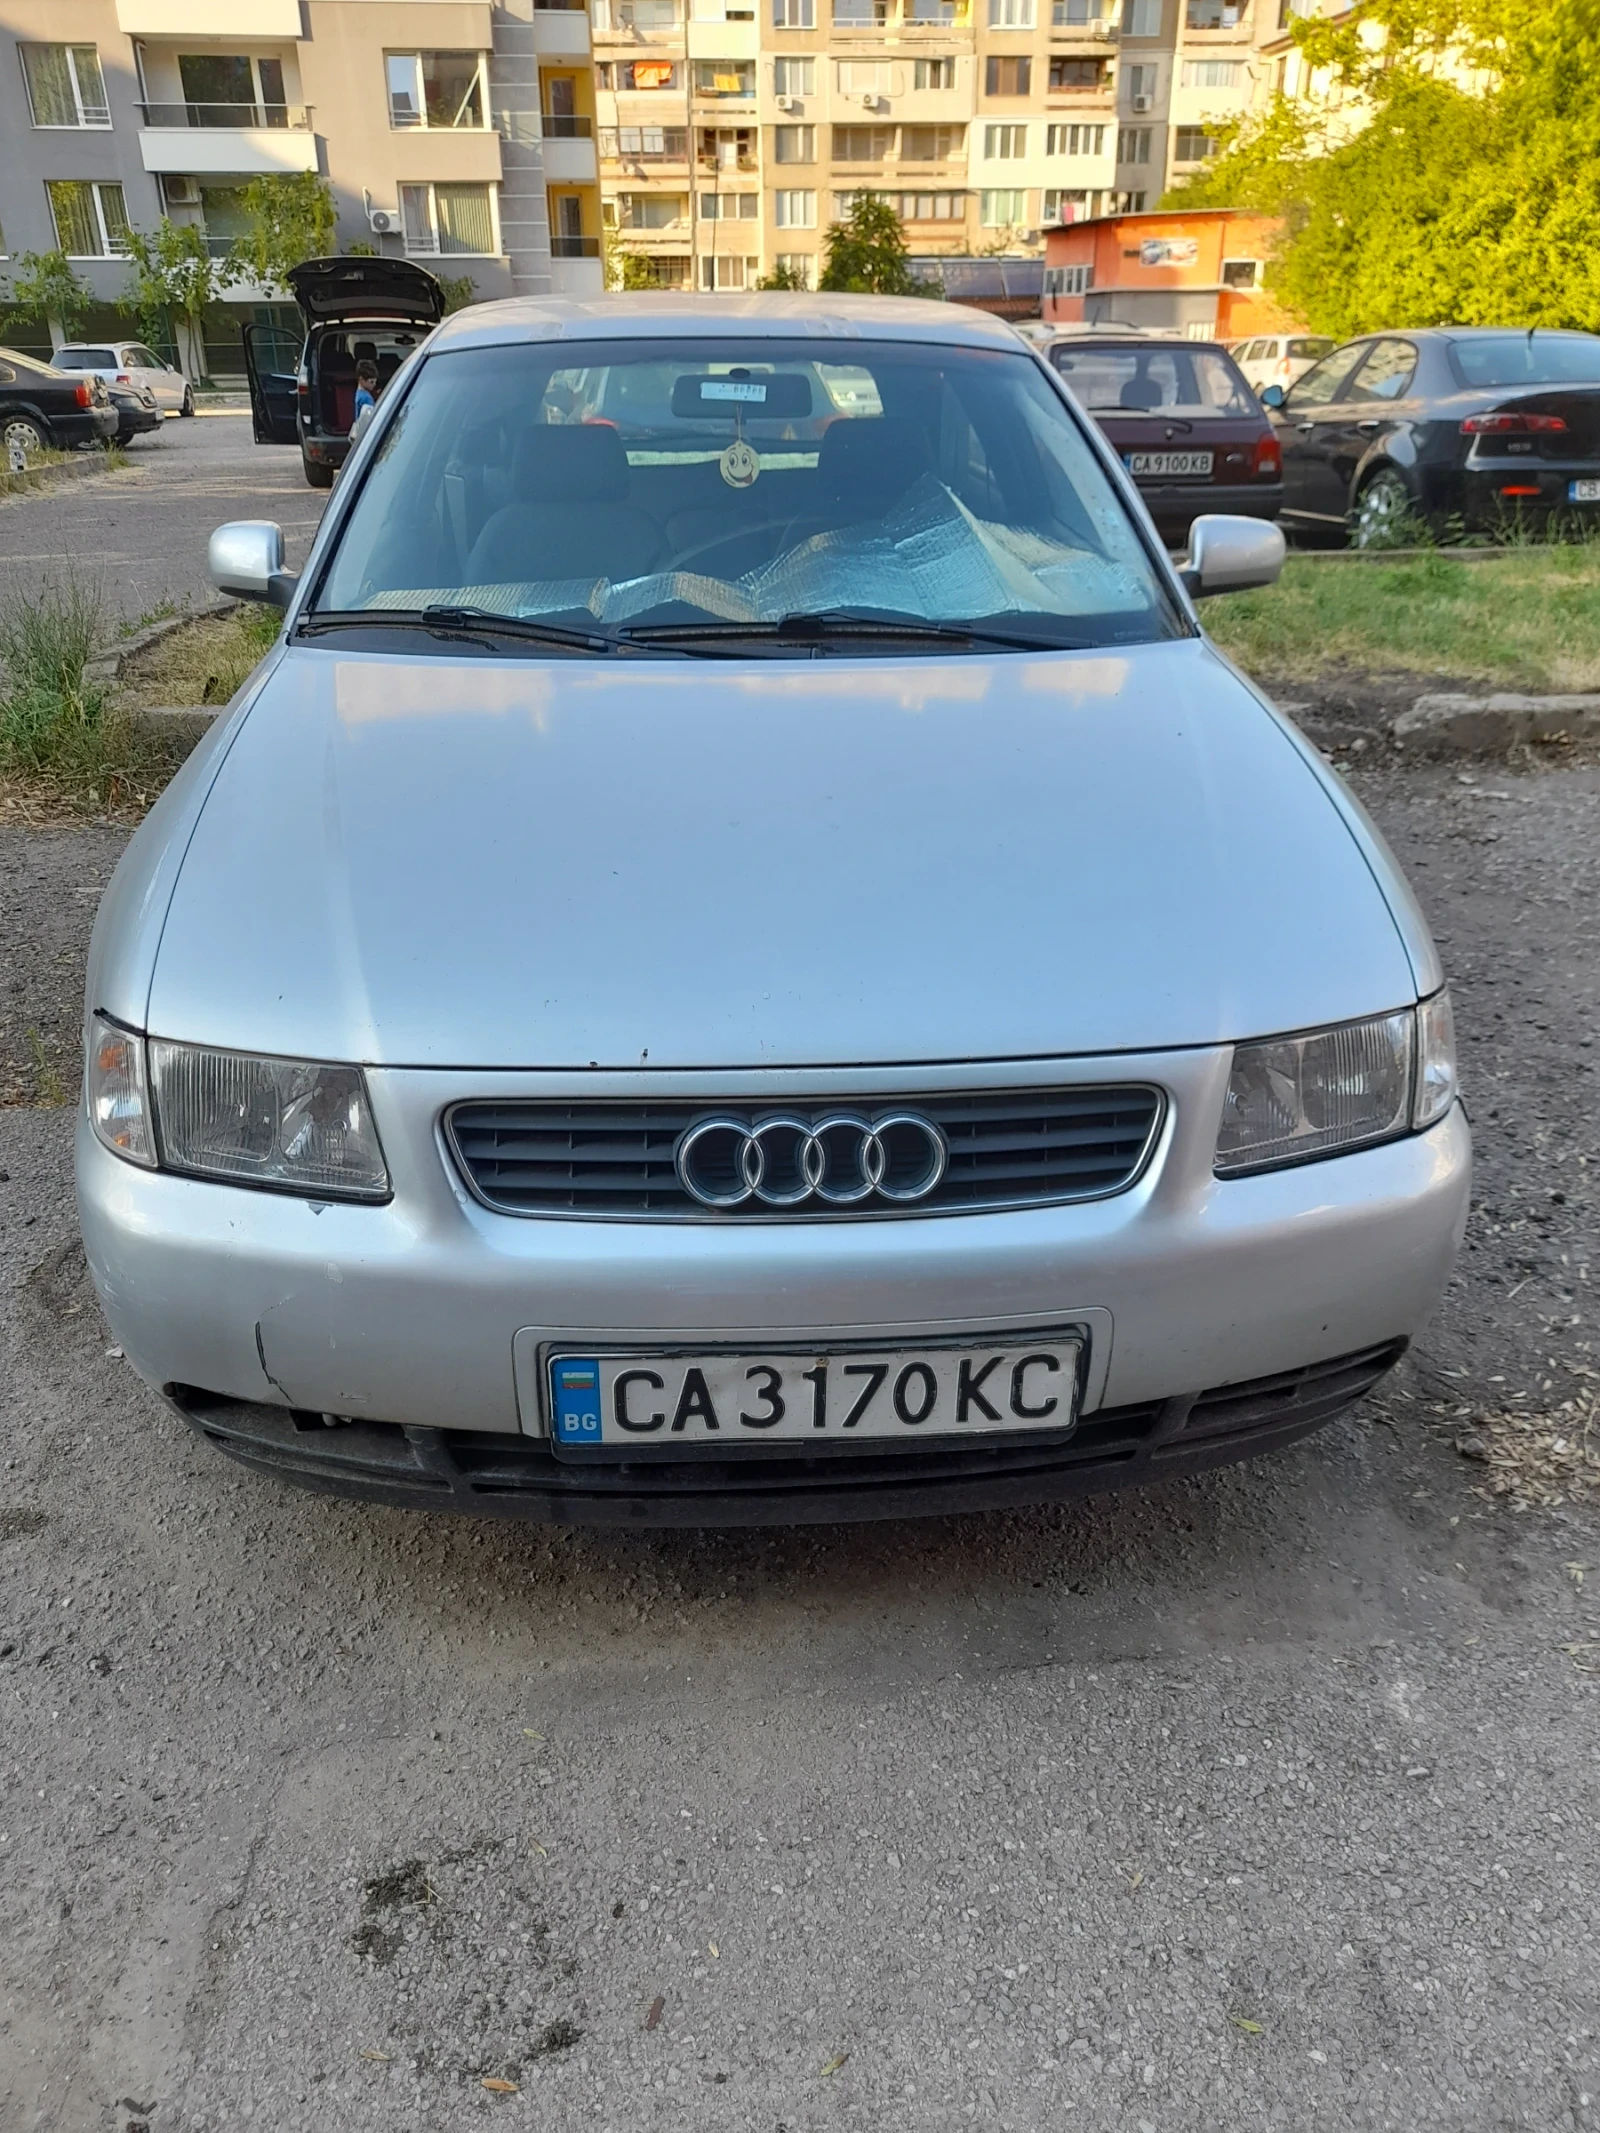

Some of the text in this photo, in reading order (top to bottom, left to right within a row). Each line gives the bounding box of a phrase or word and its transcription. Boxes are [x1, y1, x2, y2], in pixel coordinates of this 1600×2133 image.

[1133, 456, 1151, 472] CA
[1154, 455, 1188, 472] 9100
[613, 1355, 1060, 1432] CA 3170 KC
[563, 1413, 597, 1432] BG
